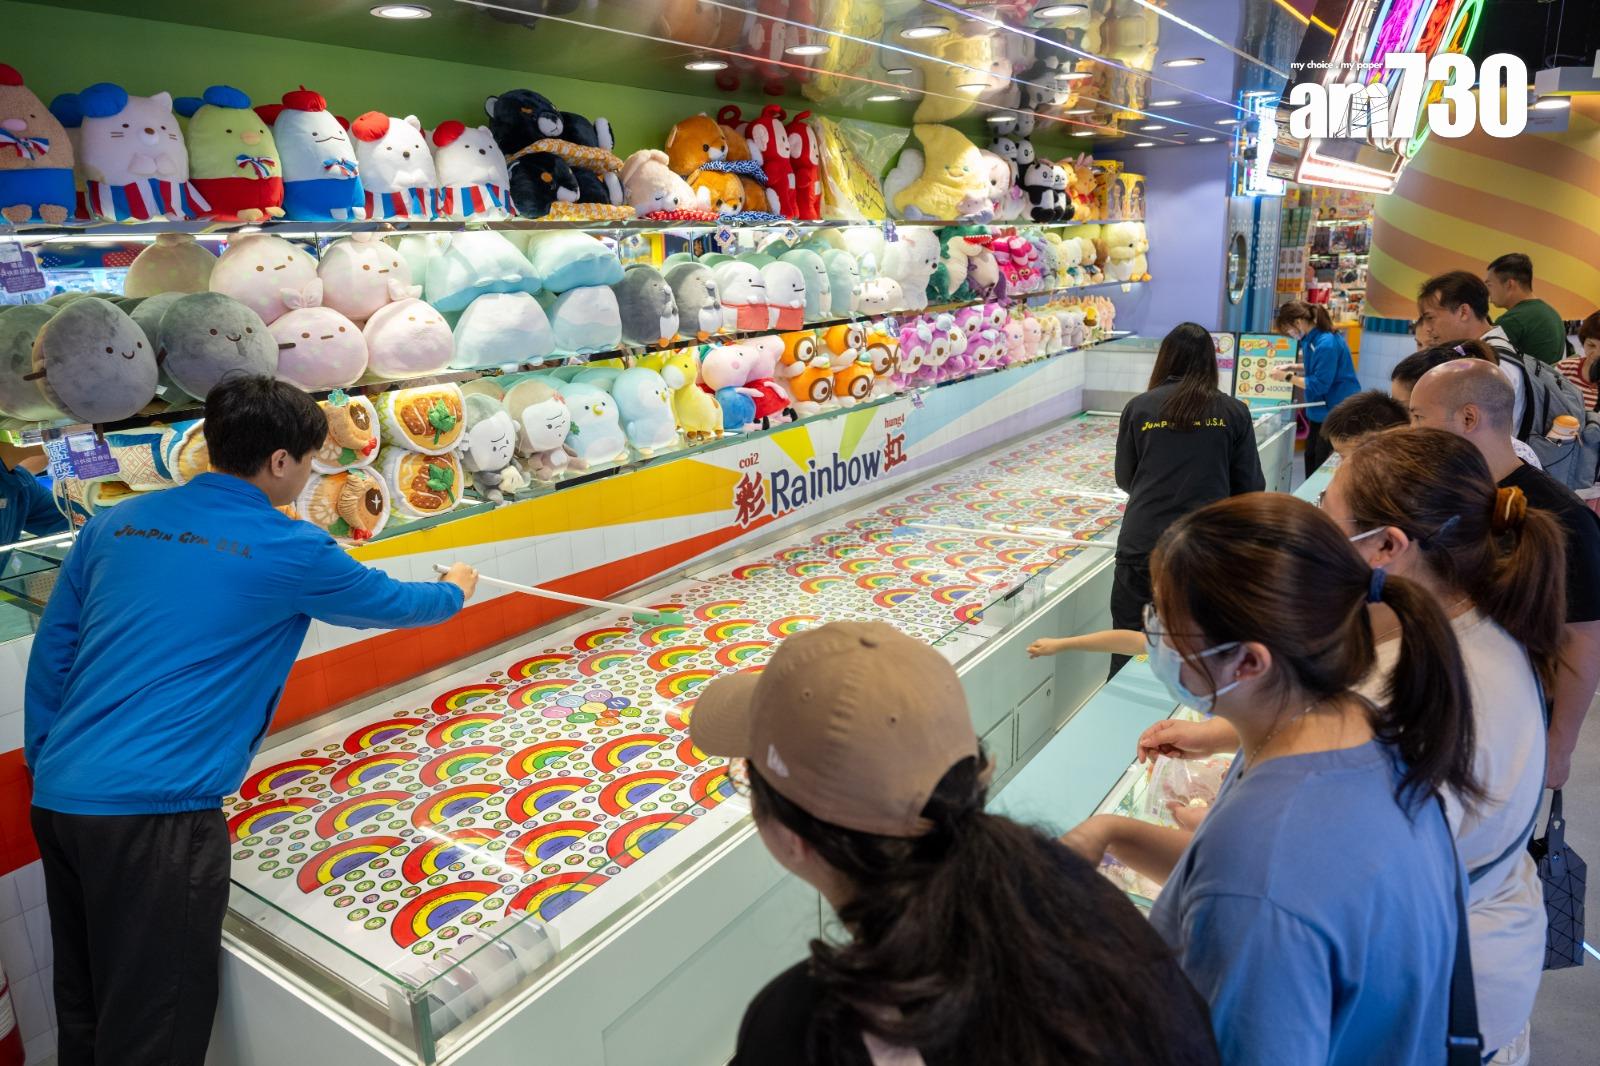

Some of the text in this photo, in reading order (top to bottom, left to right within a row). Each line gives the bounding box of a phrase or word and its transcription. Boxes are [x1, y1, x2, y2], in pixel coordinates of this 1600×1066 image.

[884, 414, 905, 429] hung4
[739, 453, 759, 469] coi2
[735, 433, 907, 525] 彩 Rainbow 虹
